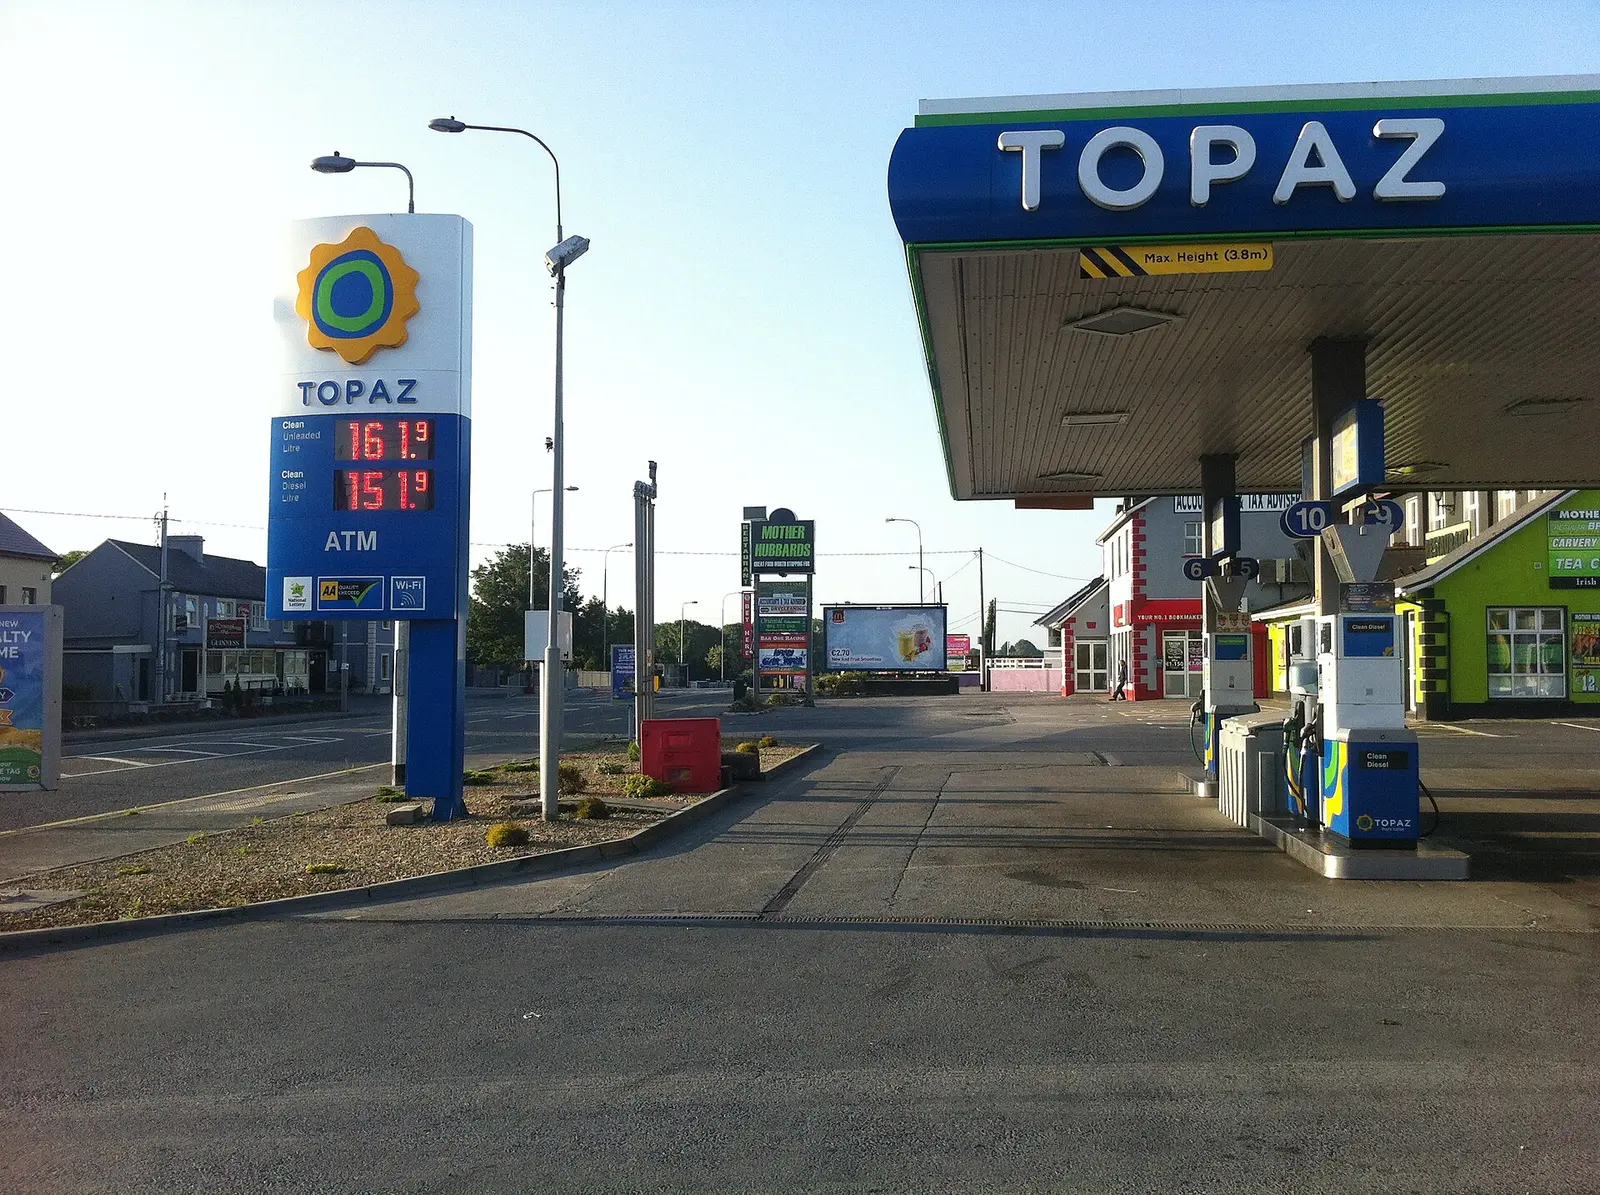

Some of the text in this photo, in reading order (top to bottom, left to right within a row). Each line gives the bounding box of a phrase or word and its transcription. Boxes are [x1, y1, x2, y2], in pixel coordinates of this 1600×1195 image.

[997, 118, 1447, 211] TOPAZ
[1144, 248, 1268, 264] Max. Height (3.8m)
[297, 379, 418, 406] TOPAZ
[282, 421, 305, 429] Clean
[283, 431, 321, 441] Unleaded
[283, 444, 300, 453] Litre
[281, 470, 304, 479] Clean
[282, 482, 307, 490] Diesel
[281, 494, 300, 502] Litre
[1249, 495, 1263, 509] TAX
[1295, 506, 1326, 531] 10
[1375, 505, 1392, 524] 9
[761, 525, 806, 539] MOTHER
[324, 531, 377, 552] ATM
[1552, 538, 1598, 548] CARVERY
[754, 543, 811, 557] HUBBARDS
[1240, 561, 1252, 577] 5
[1556, 558, 1583, 569] TEA
[1190, 562, 1202, 577] 6
[395, 580, 422, 590] Wi-Fi
[1576, 577, 1597, 586] Irish
[322, 585, 337, 596] AA
[1367, 752, 1388, 760] Clean
[6, 767, 21, 775] TAG
[1375, 819, 1411, 827] TOPAZ
